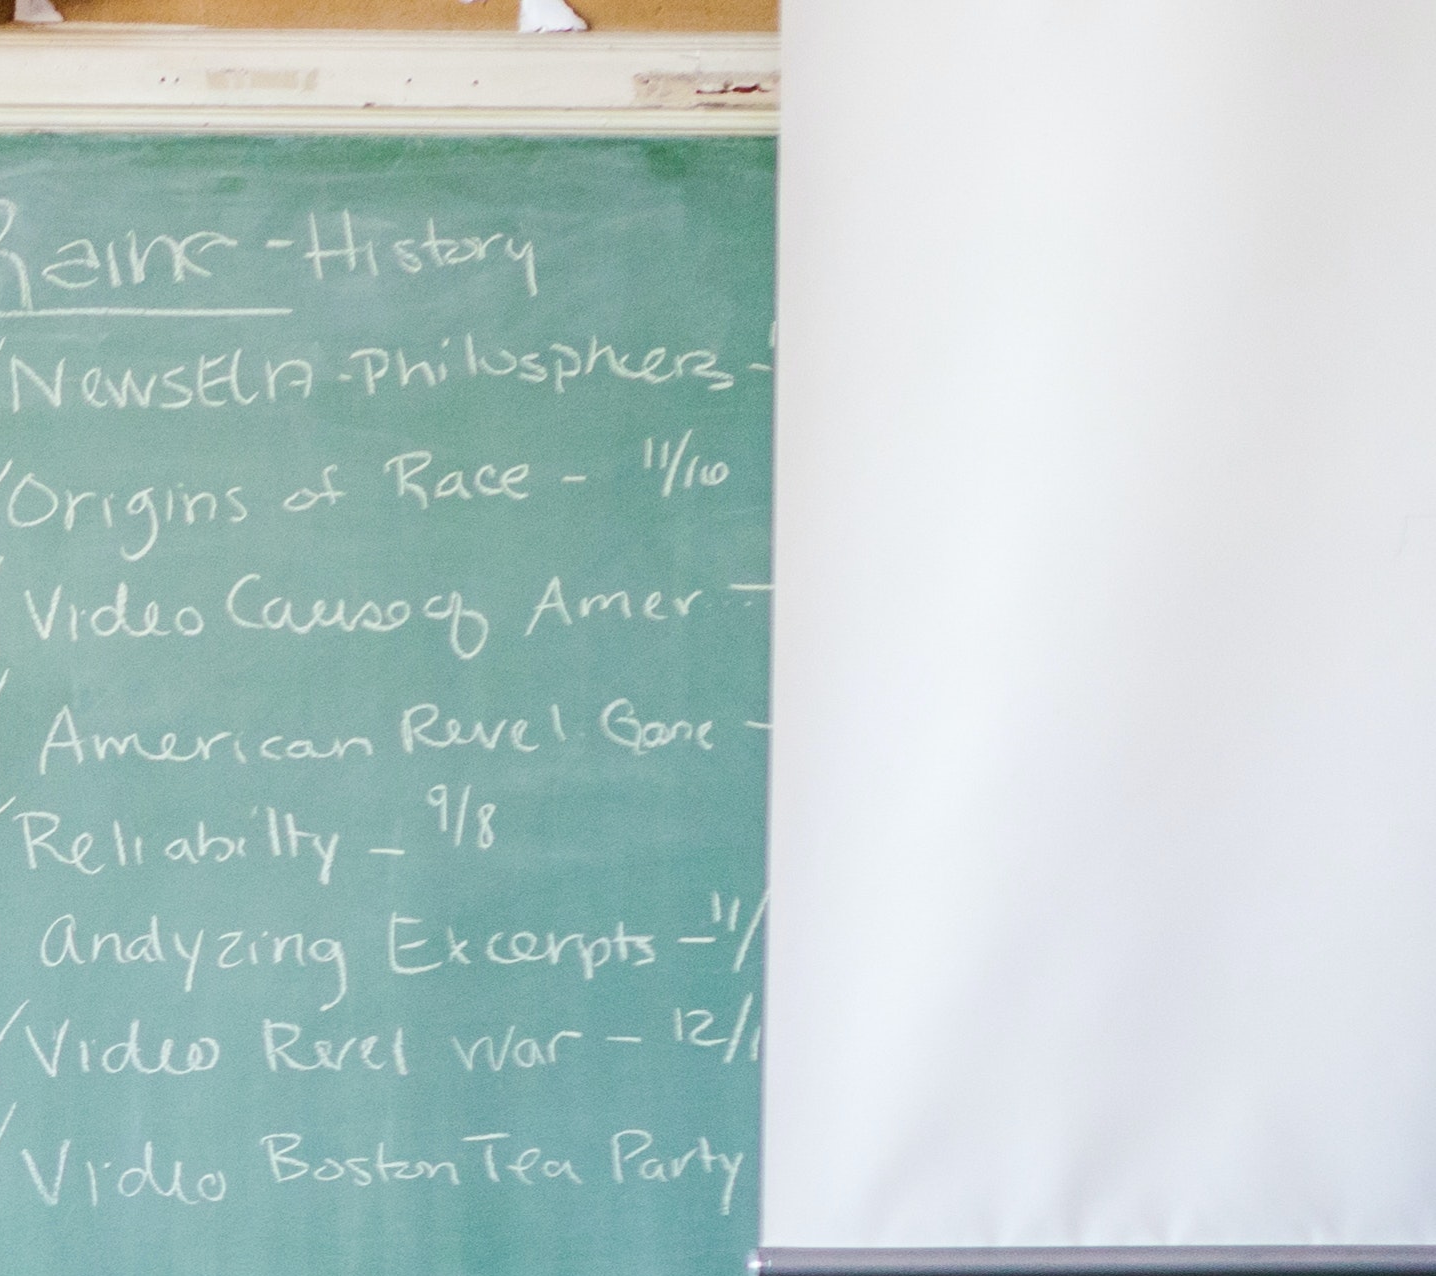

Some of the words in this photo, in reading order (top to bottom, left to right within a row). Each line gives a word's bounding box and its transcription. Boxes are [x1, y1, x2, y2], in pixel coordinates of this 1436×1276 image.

[304, 210, 537, 296] History
[8, 473, 247, 560] Origins
[283, 466, 344, 515] of
[385, 450, 530, 508] Race
[25, 582, 203, 643] Video
[525, 575, 703, 636] Amer
[39, 706, 374, 775] American
[427, 784, 496, 850] 9/8
[387, 915, 657, 979] Excerpts
[25, 1019, 222, 1078] Video
[22, 1139, 226, 1207] Video
[260, 1133, 459, 1186] Boston
[461, 1132, 581, 1184] Tea
[610, 1130, 744, 1215] Party
